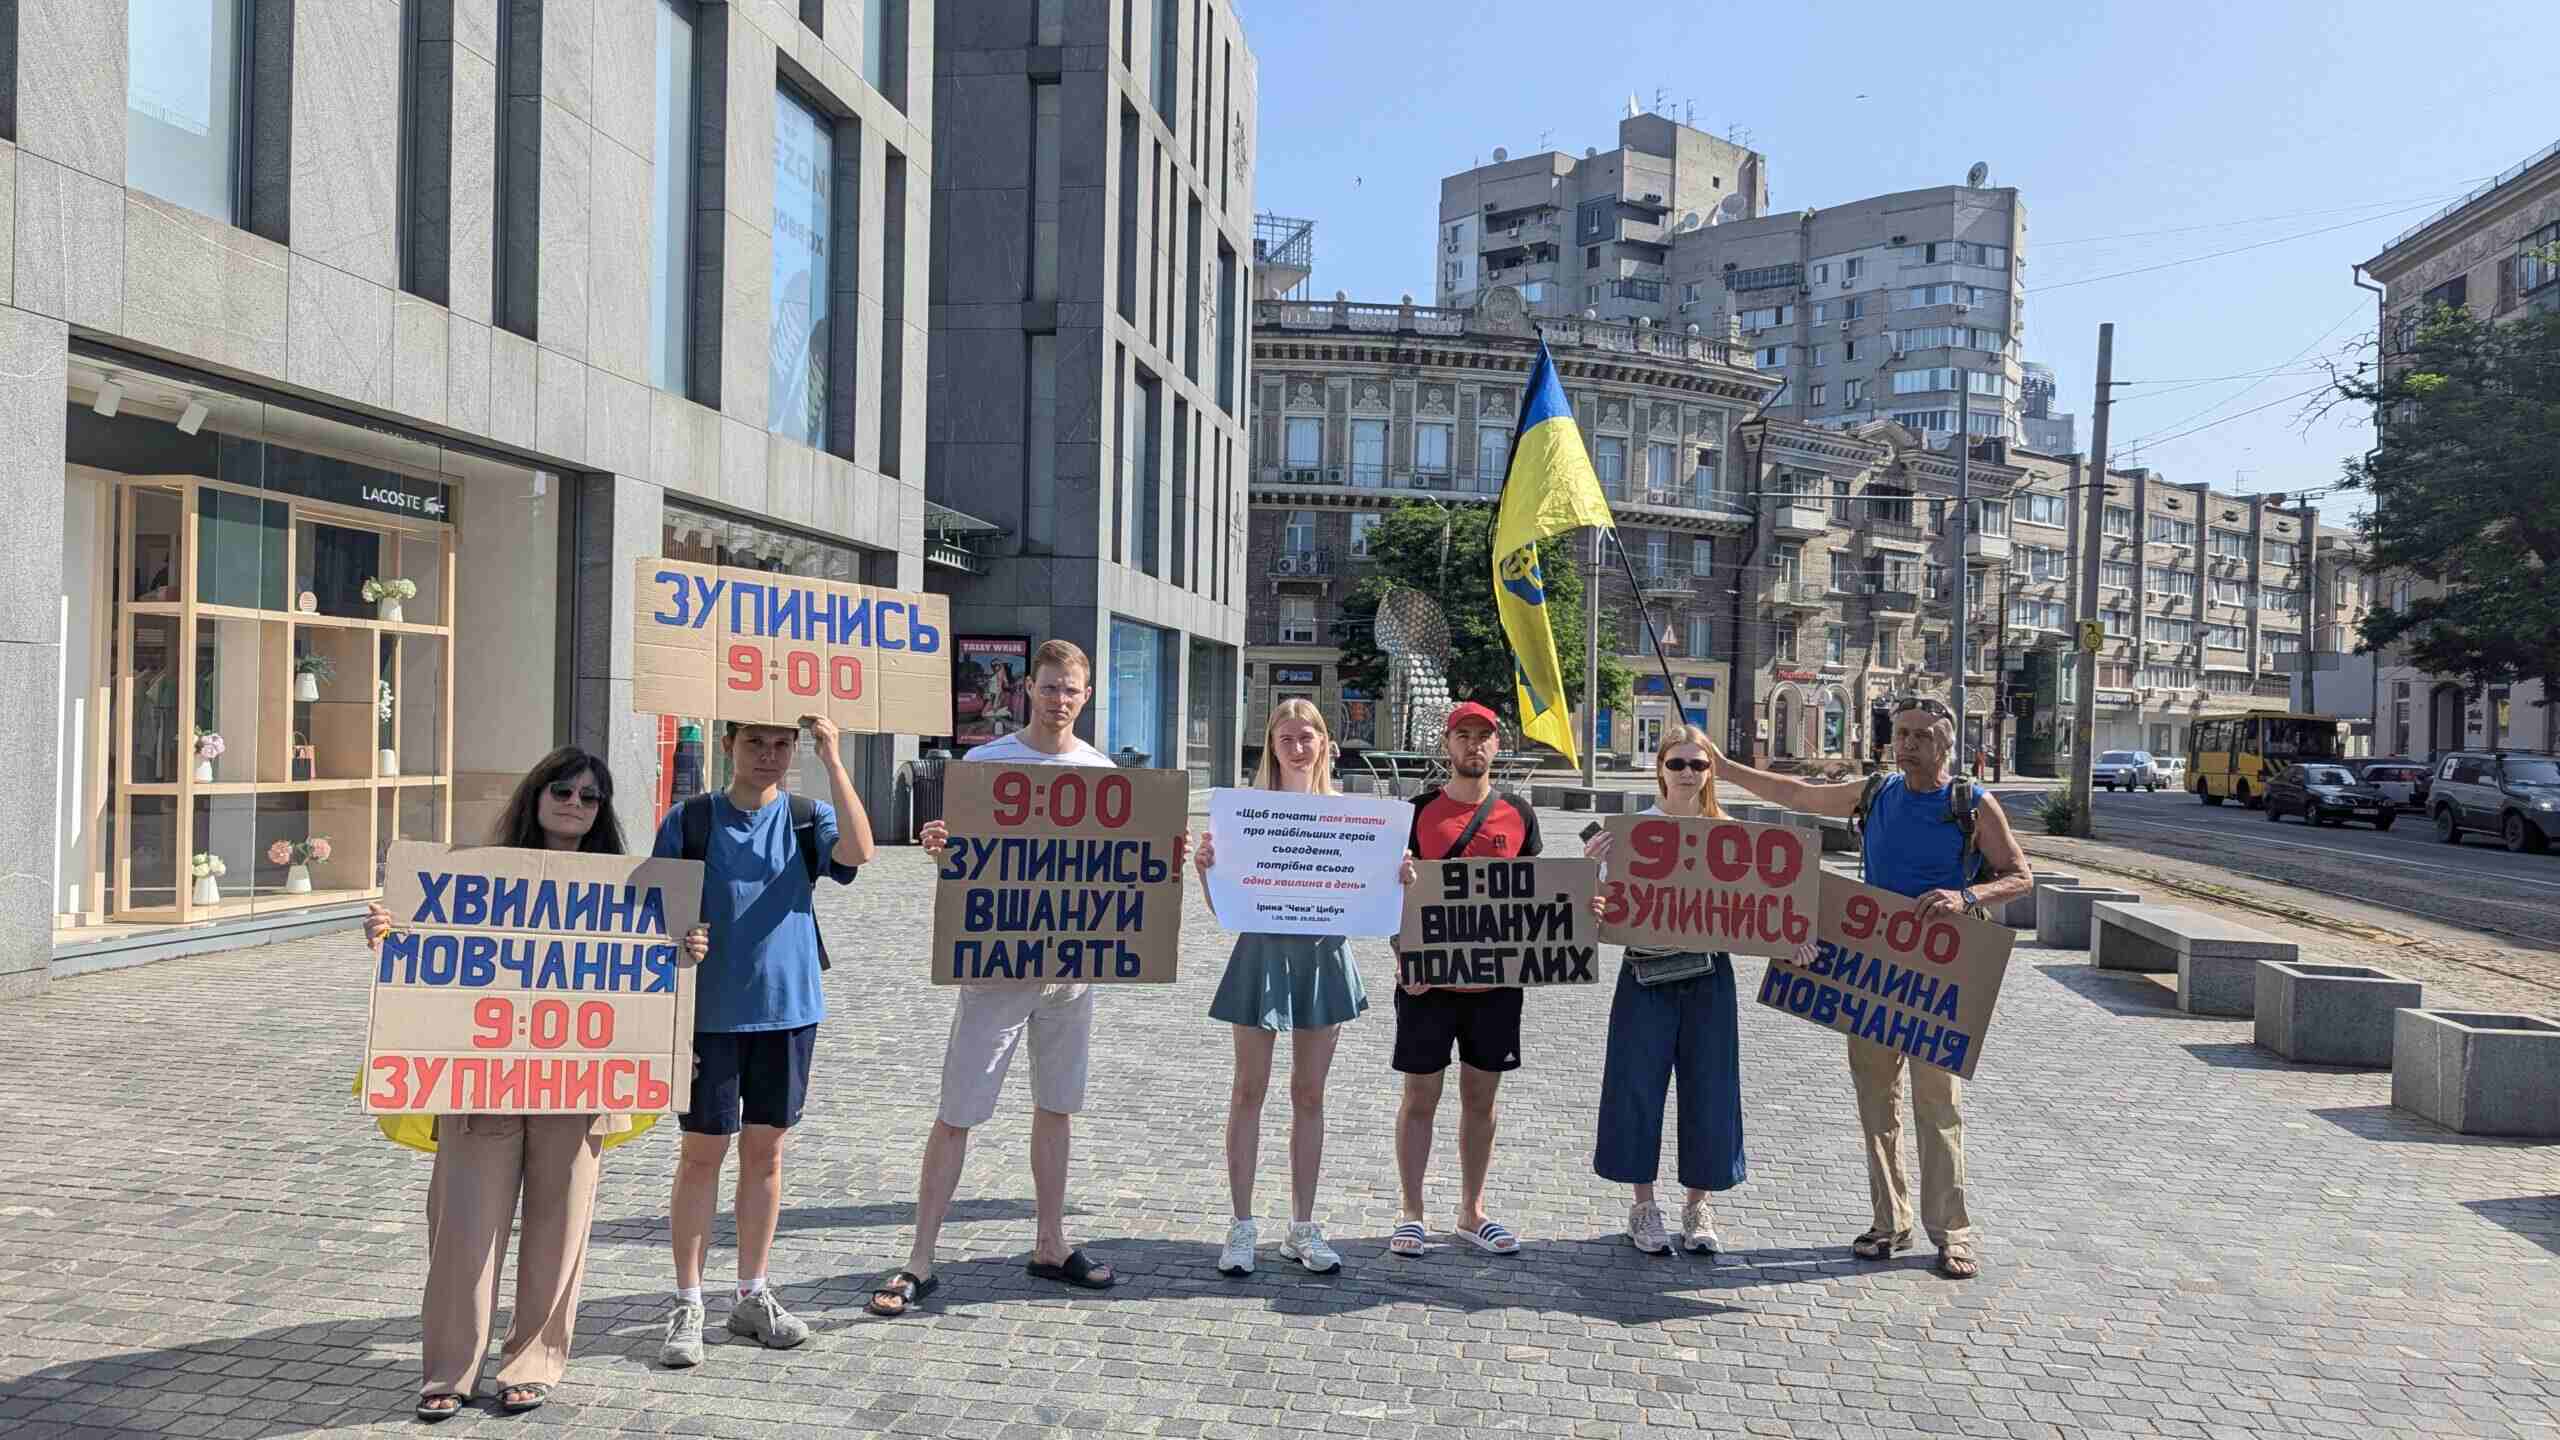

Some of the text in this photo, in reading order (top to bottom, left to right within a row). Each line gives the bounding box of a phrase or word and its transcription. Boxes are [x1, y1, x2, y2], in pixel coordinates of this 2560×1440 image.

[362, 485, 421, 510] LACOSTE
[654, 570, 940, 653] ЗУПИНИСЬ
[727, 644, 862, 700] 9:00
[992, 771, 1132, 828] 9:00
[1271, 810, 1317, 822] почати
[940, 835, 1184, 884] ЗУПИНИСЬ!
[1243, 827, 1376, 843] про найбільших героїв
[1272, 845, 1343, 857] сьогодення,
[1629, 820, 1803, 888] 9:00
[1242, 876, 1271, 886] одна
[1273, 878, 1323, 888] хвилина
[1324, 881, 1332, 889] в
[1256, 860, 1355, 873] потрібна всього
[1442, 862, 1535, 900] 9:00
[412, 871, 666, 934] ХВИЛИНА
[964, 884, 1145, 932] ВШАНУЙ
[1256, 903, 1283, 912] Ірина
[1421, 893, 1573, 944] ВШАНУЙ
[1603, 881, 1810, 945] ЗУПИНИСЬ
[1840, 895, 1961, 965] 9:00
[379, 931, 677, 993] МОВЧАННЯ
[953, 936, 1141, 979] ПАМ'ЯТЬ
[1400, 945, 1594, 985] ПОЛЕГЛИХ
[1790, 939, 1960, 1022] ВИЛИНА
[472, 997, 615, 1050] 9:00
[1763, 967, 1970, 1073] МОВЧАННЯ
[369, 1055, 670, 1110] ЗУПИНИСЬ
